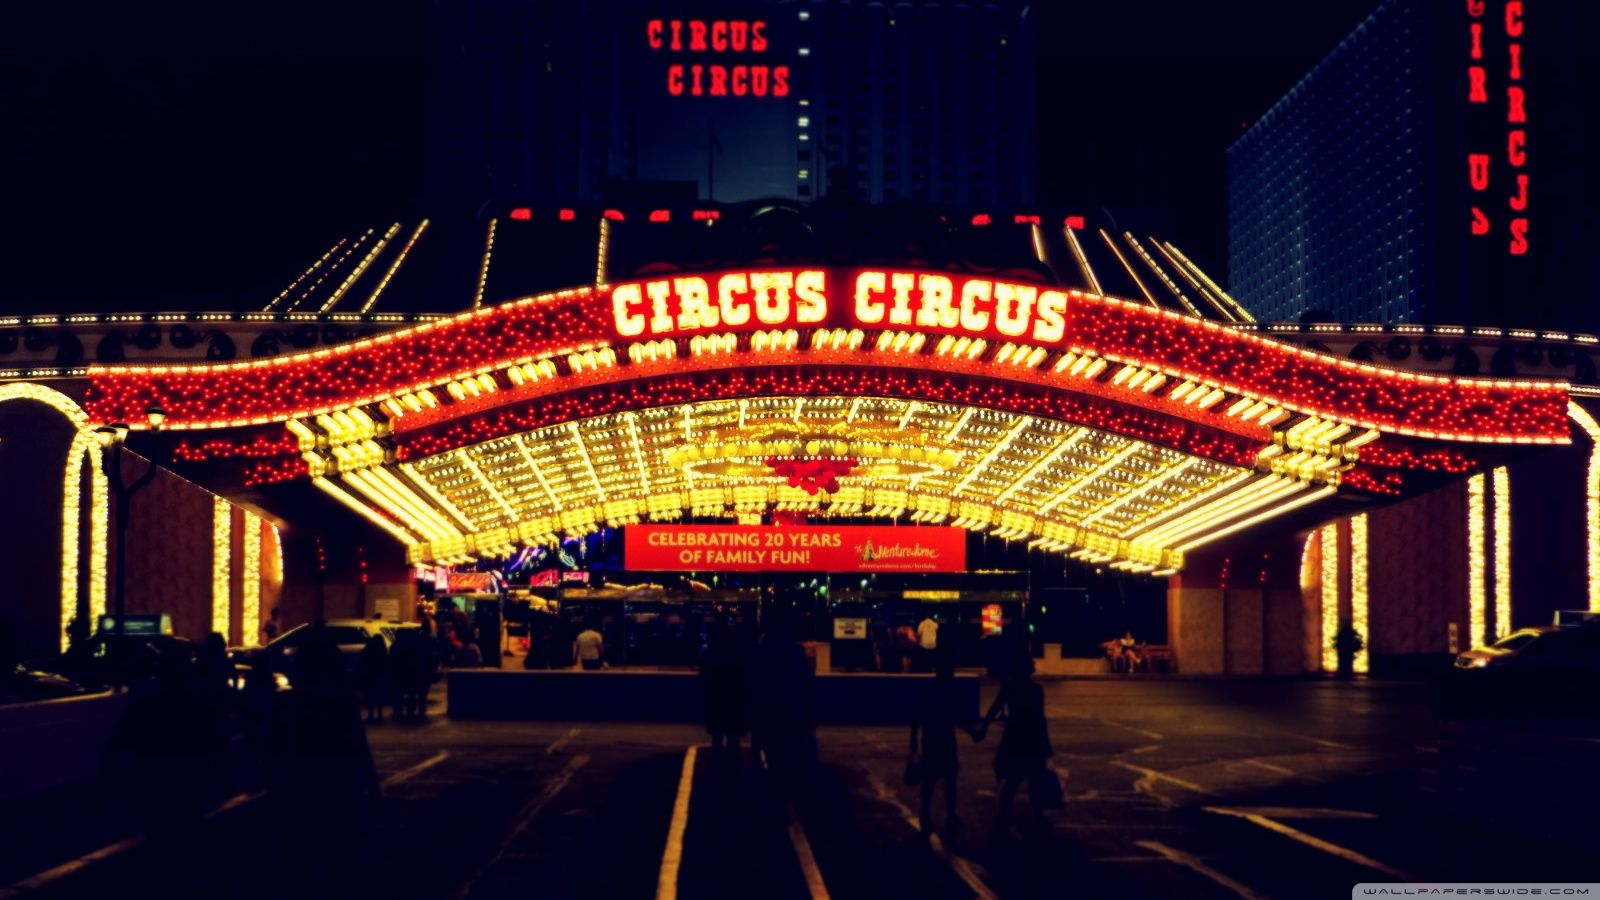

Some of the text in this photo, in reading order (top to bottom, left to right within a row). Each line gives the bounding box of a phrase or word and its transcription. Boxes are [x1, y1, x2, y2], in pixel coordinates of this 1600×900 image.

[647, 19, 768, 52] CIRCUS
[668, 64, 789, 97] CIRCUS
[611, 270, 1067, 343] CIRCUS CIRCUS
[648, 532, 842, 547] CELEBRATING 20 YEARS
[679, 549, 811, 564] OF FAMILY FUN!
